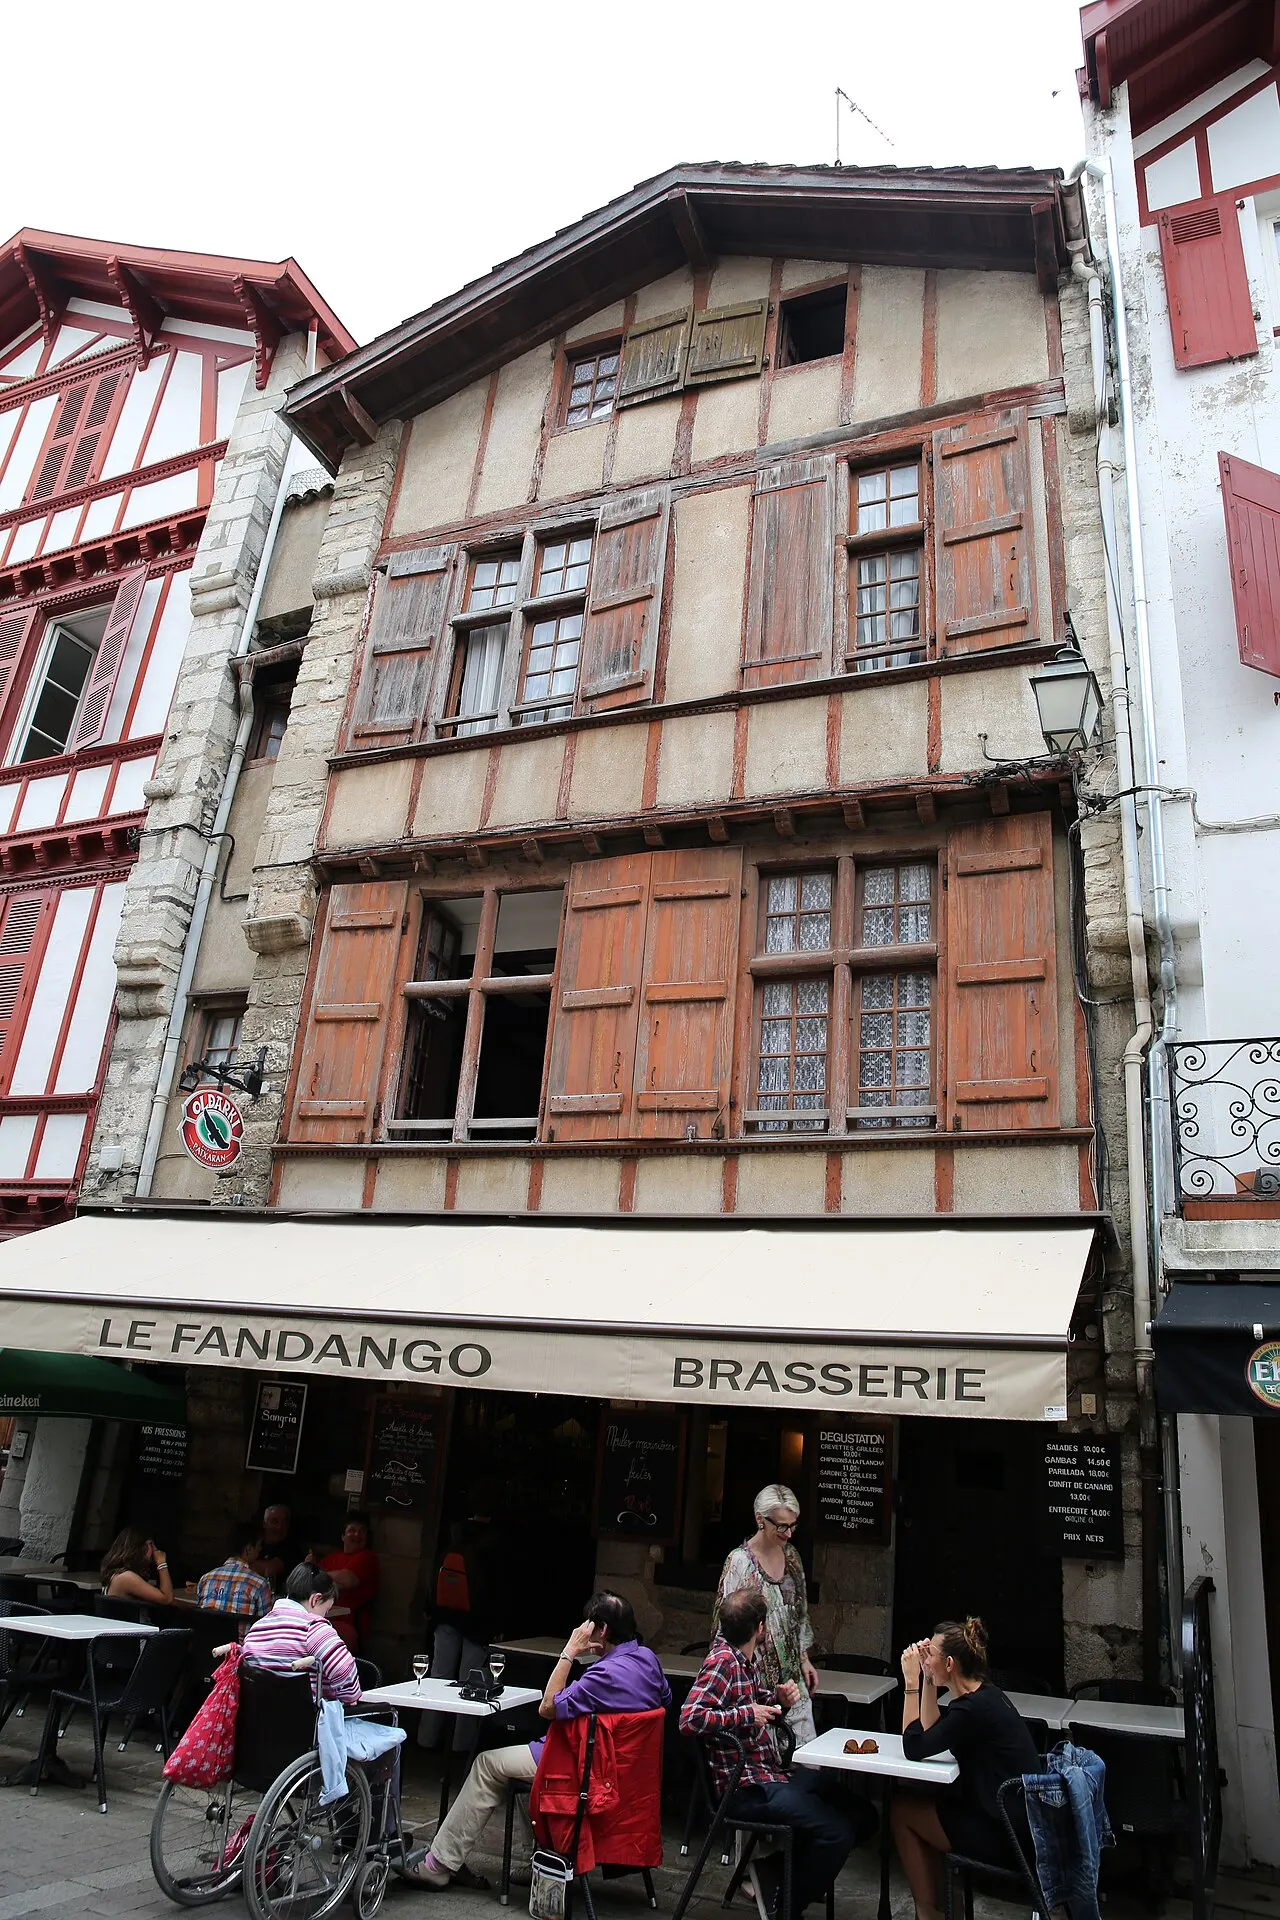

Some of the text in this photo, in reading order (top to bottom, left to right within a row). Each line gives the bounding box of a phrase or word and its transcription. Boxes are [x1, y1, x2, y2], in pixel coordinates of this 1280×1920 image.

[192, 1093, 241, 1129] OLDARKI
[193, 1142, 226, 1162] PATXARAN
[99, 1318, 492, 1378] LE FANDANGO
[672, 1357, 986, 1402] BRASSERIE
[261, 1410, 297, 1428] Sangria
[141, 1426, 187, 1439] NOS PRESSIONS
[820, 1431, 885, 1444] DEGUSTATION
[820, 1443, 854, 1451] CREVETTES
[1046, 1443, 1078, 1452] SALADES
[1044, 1456, 1077, 1465] GAMBAS
[820, 1469, 848, 1477] SARDINES
[1048, 1467, 1085, 1476] PARILLADA
[1048, 1480, 1113, 1491] CONFIT DE CANARD
[847, 1499, 874, 1507] SERRANO
[1048, 1505, 1088, 1515] ENTRECOTE
[851, 1516, 875, 1524] BASQUE
[1063, 1533, 1104, 1543] PRIX NETS
